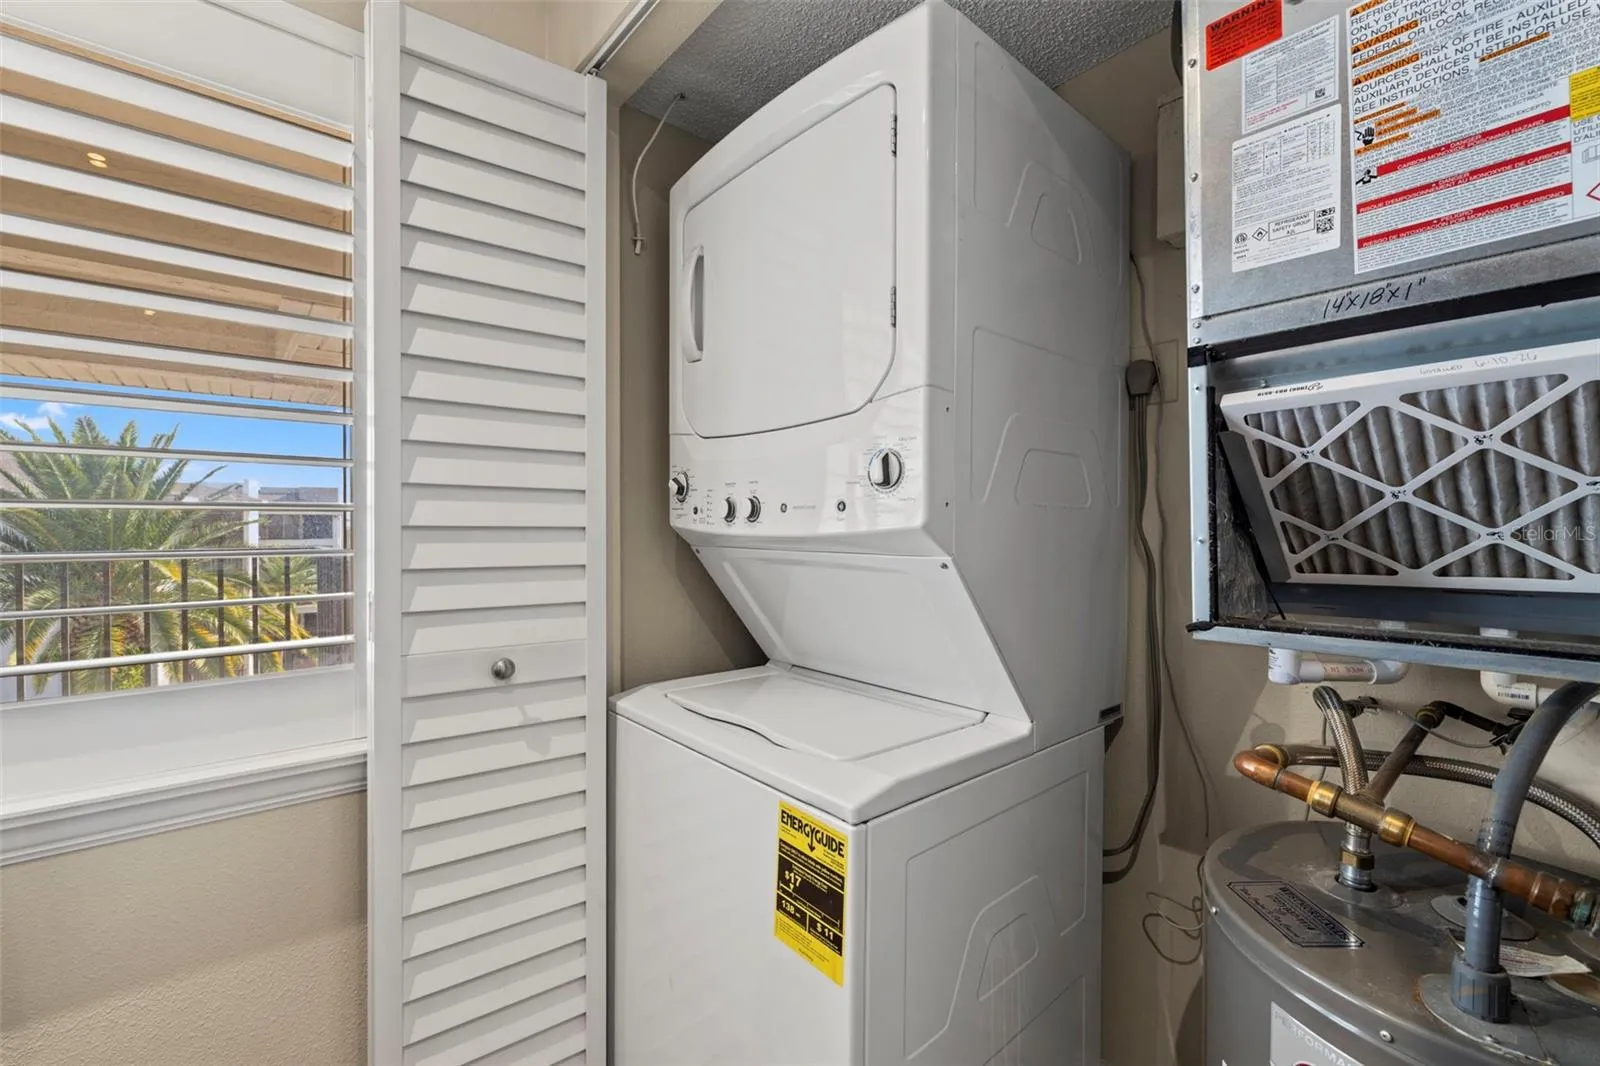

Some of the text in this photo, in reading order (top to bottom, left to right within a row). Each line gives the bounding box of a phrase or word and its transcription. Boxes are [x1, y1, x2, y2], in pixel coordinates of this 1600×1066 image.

[1350, 16, 1380, 36] ONLY
[1384, 8, 1399, 21] BY
[1351, 32, 1367, 45] DO
[1370, 20, 1394, 37] NOT
[1352, 35, 1403, 63] FEDERAL
[1407, 26, 1425, 40] OR
[1429, 6, 1470, 31] LOCAL
[1353, 67, 1408, 96] SOURCES
[1412, 51, 1450, 73] SHALL
[1454, 39, 1481, 56] NOT
[1486, 30, 1503, 43] BE
[1508, 0, 1588, 35] INSTALLED
[1362, 19, 1418, 48] WARNING
[1420, 5, 1448, 24] RISK
[1353, 6, 1590, 105] AUXILIARY DEVICES LISTED FOR USE
[1363, 53, 1418, 81] WARNING
[1420, 41, 1448, 59] RISK
[1452, 32, 1469, 46] OF
[1474, 19, 1503, 37] FIRE
[1354, 63, 1472, 115] SEE INSTRUCTIONS.
[780, 808, 845, 858] ENERGYGUIDE
